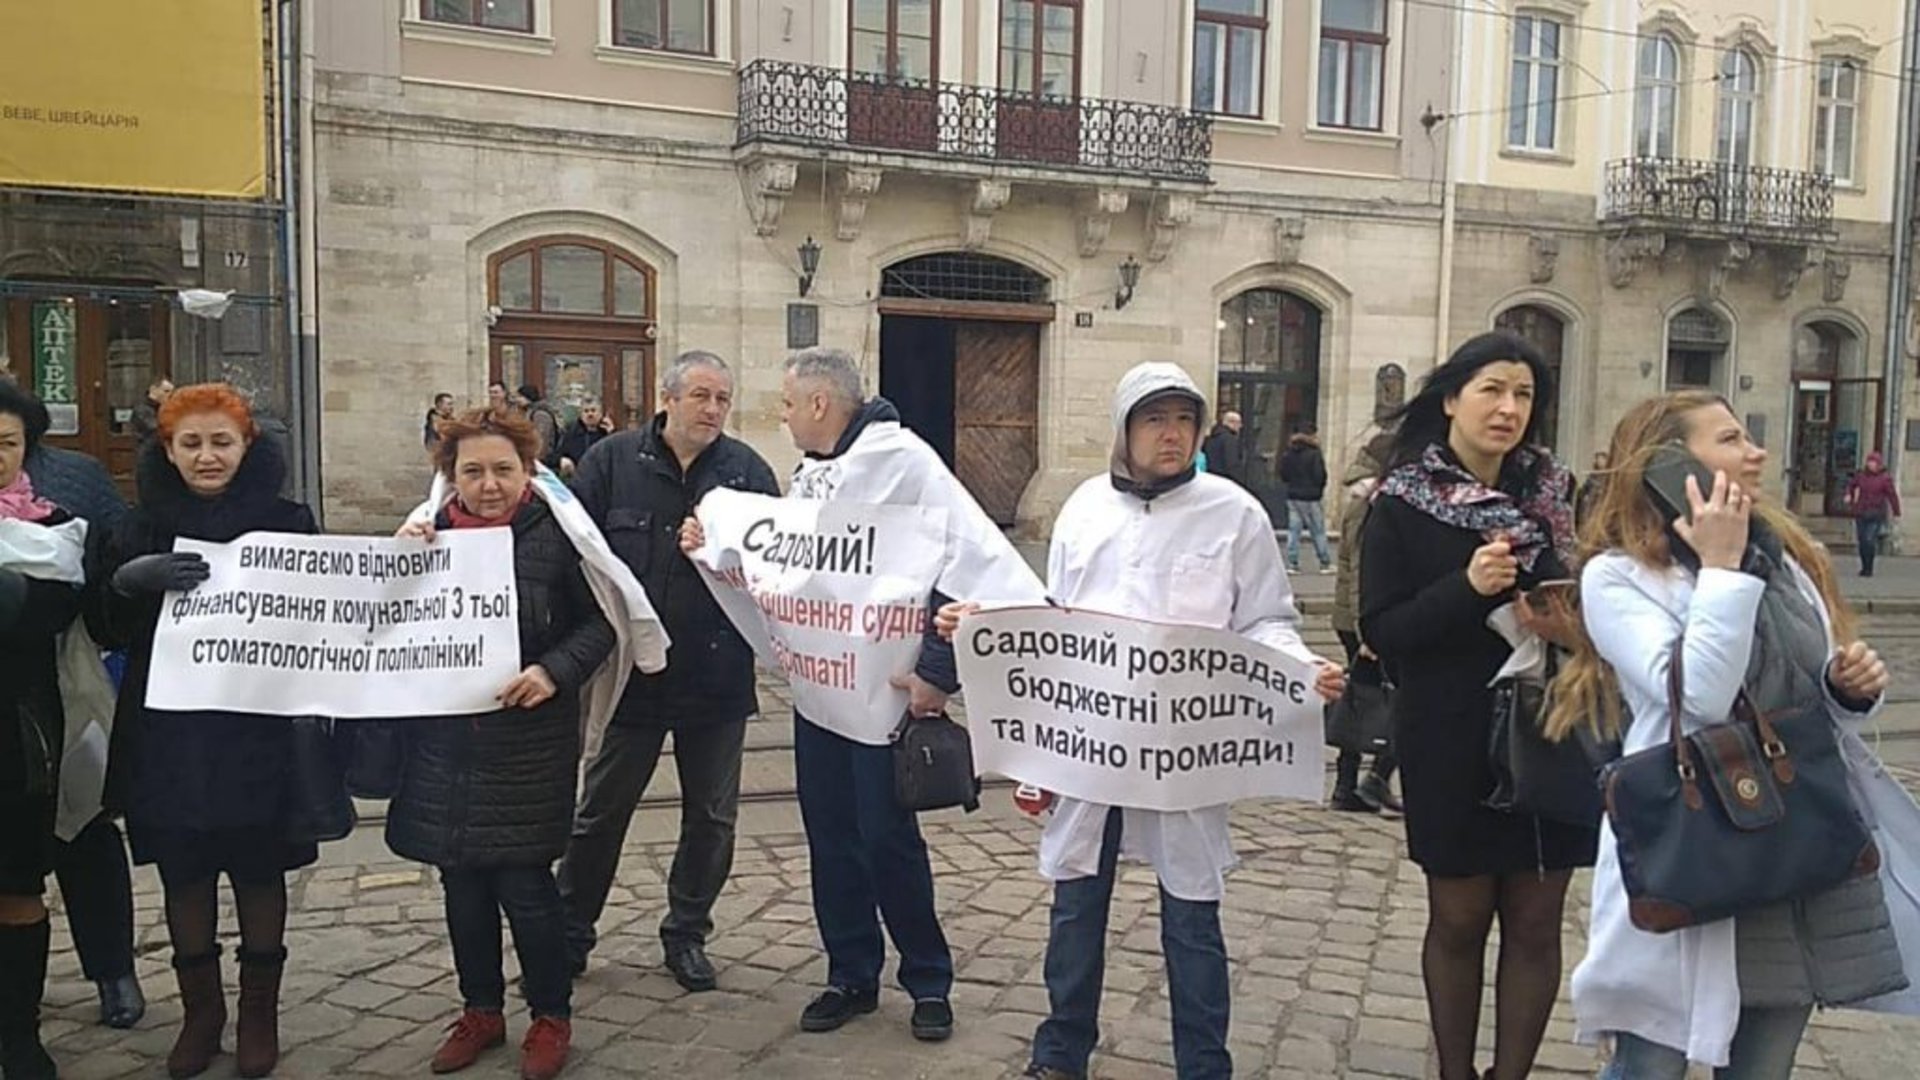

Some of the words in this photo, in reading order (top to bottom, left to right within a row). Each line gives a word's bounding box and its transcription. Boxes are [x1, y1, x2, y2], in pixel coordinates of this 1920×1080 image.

[3, 104, 45, 122] ВЕВЕ,
[227, 251, 246, 266] 17
[239, 544, 353, 576] вимагаємо
[359, 544, 451, 582] відновити
[742, 518, 876, 575] Садовий!
[171, 589, 326, 625] фінансування
[332, 588, 448, 633] комунальної
[192, 636, 373, 672] стоматологічної
[376, 634, 483, 672] поліклініки!
[972, 627, 1117, 667] Садовий
[1128, 646, 1306, 704] розкрадає
[1008, 668, 1158, 724] бюджетні
[1171, 693, 1274, 725] кошти
[992, 718, 1025, 743] та
[1035, 722, 1127, 769] майно
[1140, 738, 1294, 780] громади!
